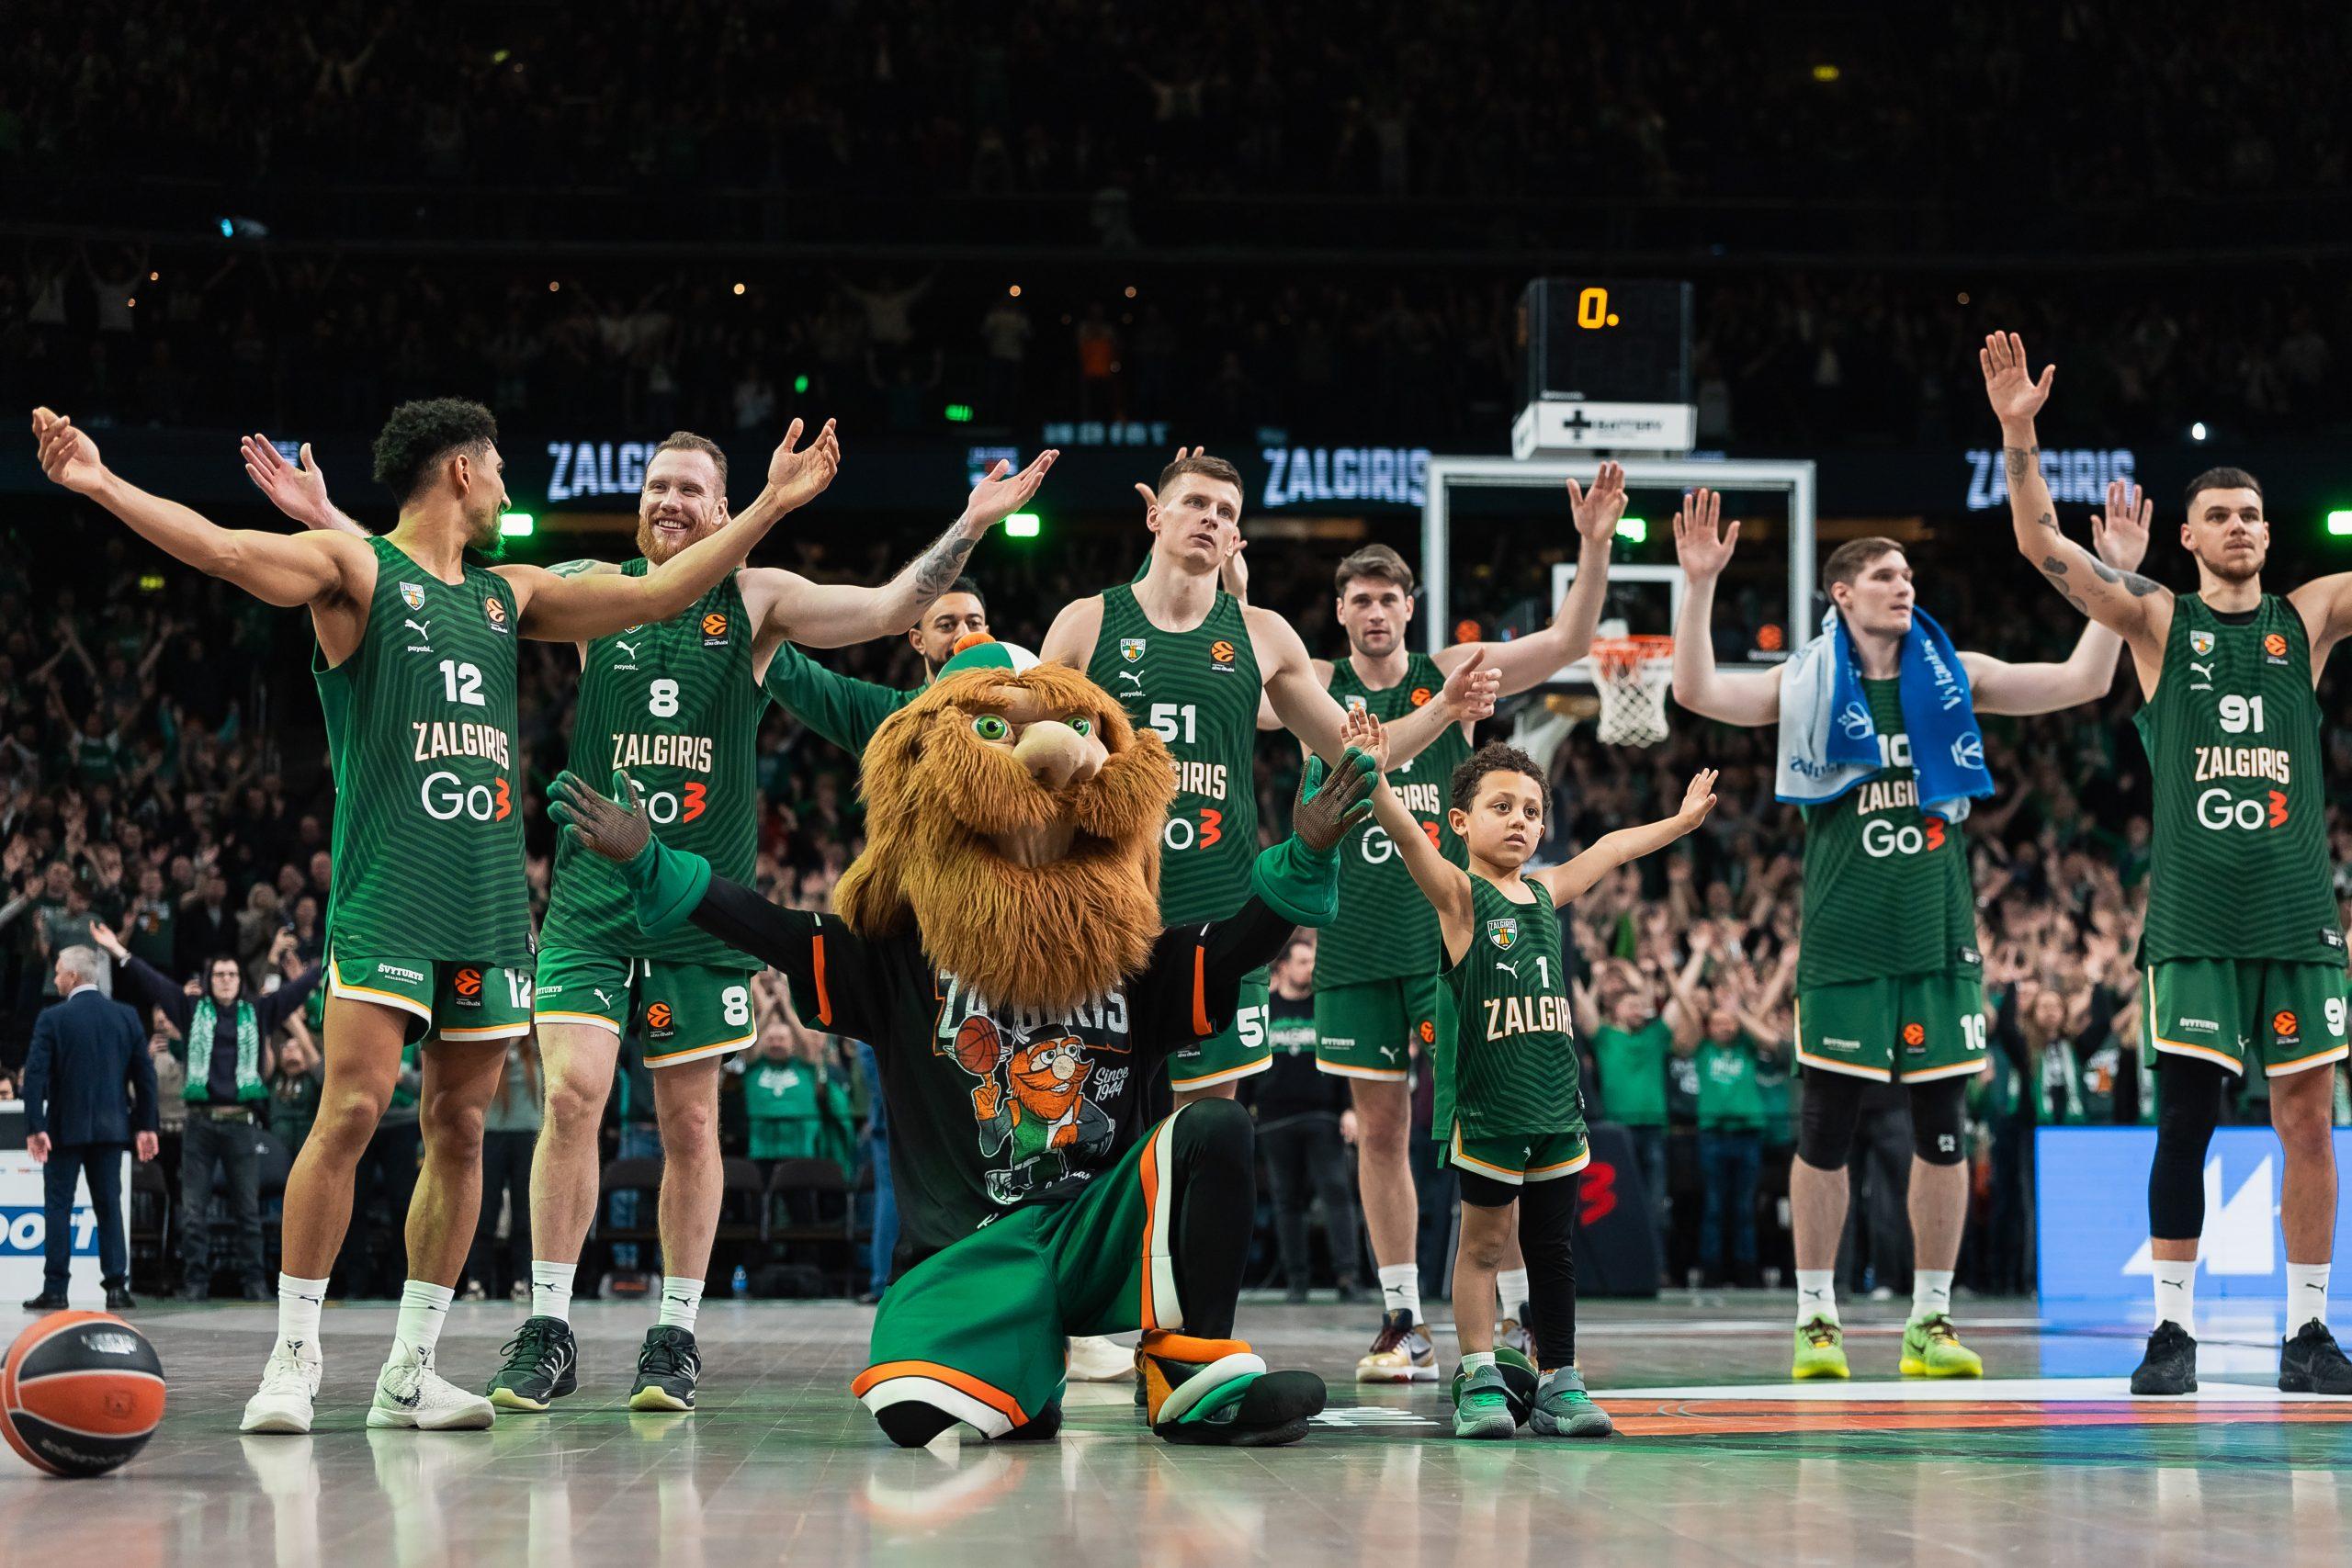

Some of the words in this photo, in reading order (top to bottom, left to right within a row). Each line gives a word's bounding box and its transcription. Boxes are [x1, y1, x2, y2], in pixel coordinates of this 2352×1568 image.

[1964, 448, 2135, 510] ZAGIRIS
[439, 659, 486, 706] 12
[649, 678, 680, 718] 8
[1149, 703, 1196, 744] 51
[2219, 694, 2265, 734] 91
[1877, 733, 1913, 769] 10
[421, 771, 512, 823] Go3
[2197, 787, 2289, 830] Go3
[1164, 807, 1223, 852] o3
[1862, 818, 1946, 858] Go3
[503, 967, 532, 1010] 12
[1535, 955, 1550, 988] 1
[721, 985, 749, 1027] 8
[1237, 1003, 1269, 1048] 51
[1960, 1012, 1986, 1051] 10
[1093, 1066, 1129, 1087] Since
[1095, 1080, 1123, 1102] 1944
